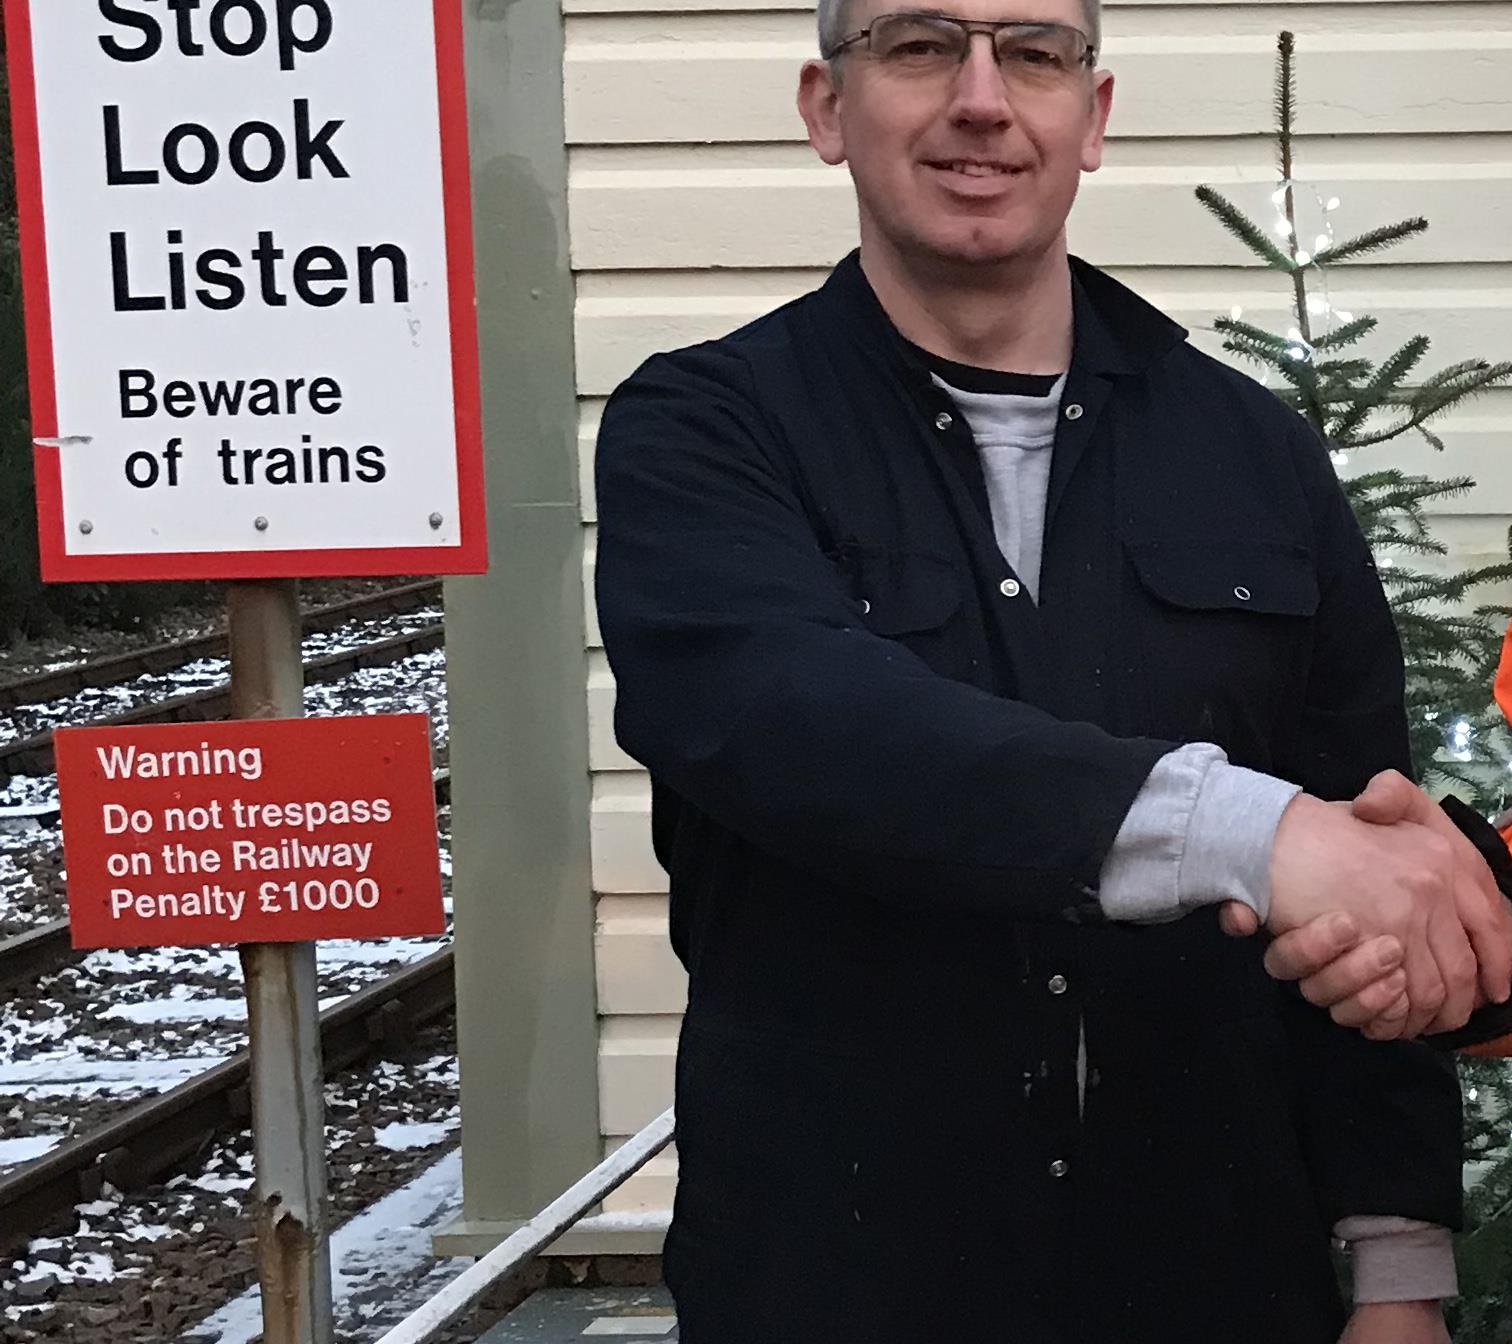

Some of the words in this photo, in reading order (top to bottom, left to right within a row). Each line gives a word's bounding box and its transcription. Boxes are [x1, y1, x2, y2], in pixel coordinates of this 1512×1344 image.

[102, 98, 350, 186] Look
[109, 229, 409, 312] Listen
[118, 369, 342, 419] Beware
[124, 437, 183, 489] of
[217, 434, 386, 485] trains
[96, 741, 263, 780] Warning
[102, 803, 153, 835] Do
[164, 799, 224, 832] not
[231, 798, 392, 832] trespass
[106, 851, 152, 877] on
[161, 843, 221, 875] the
[232, 838, 373, 873] Railway
[110, 884, 246, 921] Penalty
[258, 878, 380, 913] £1000
